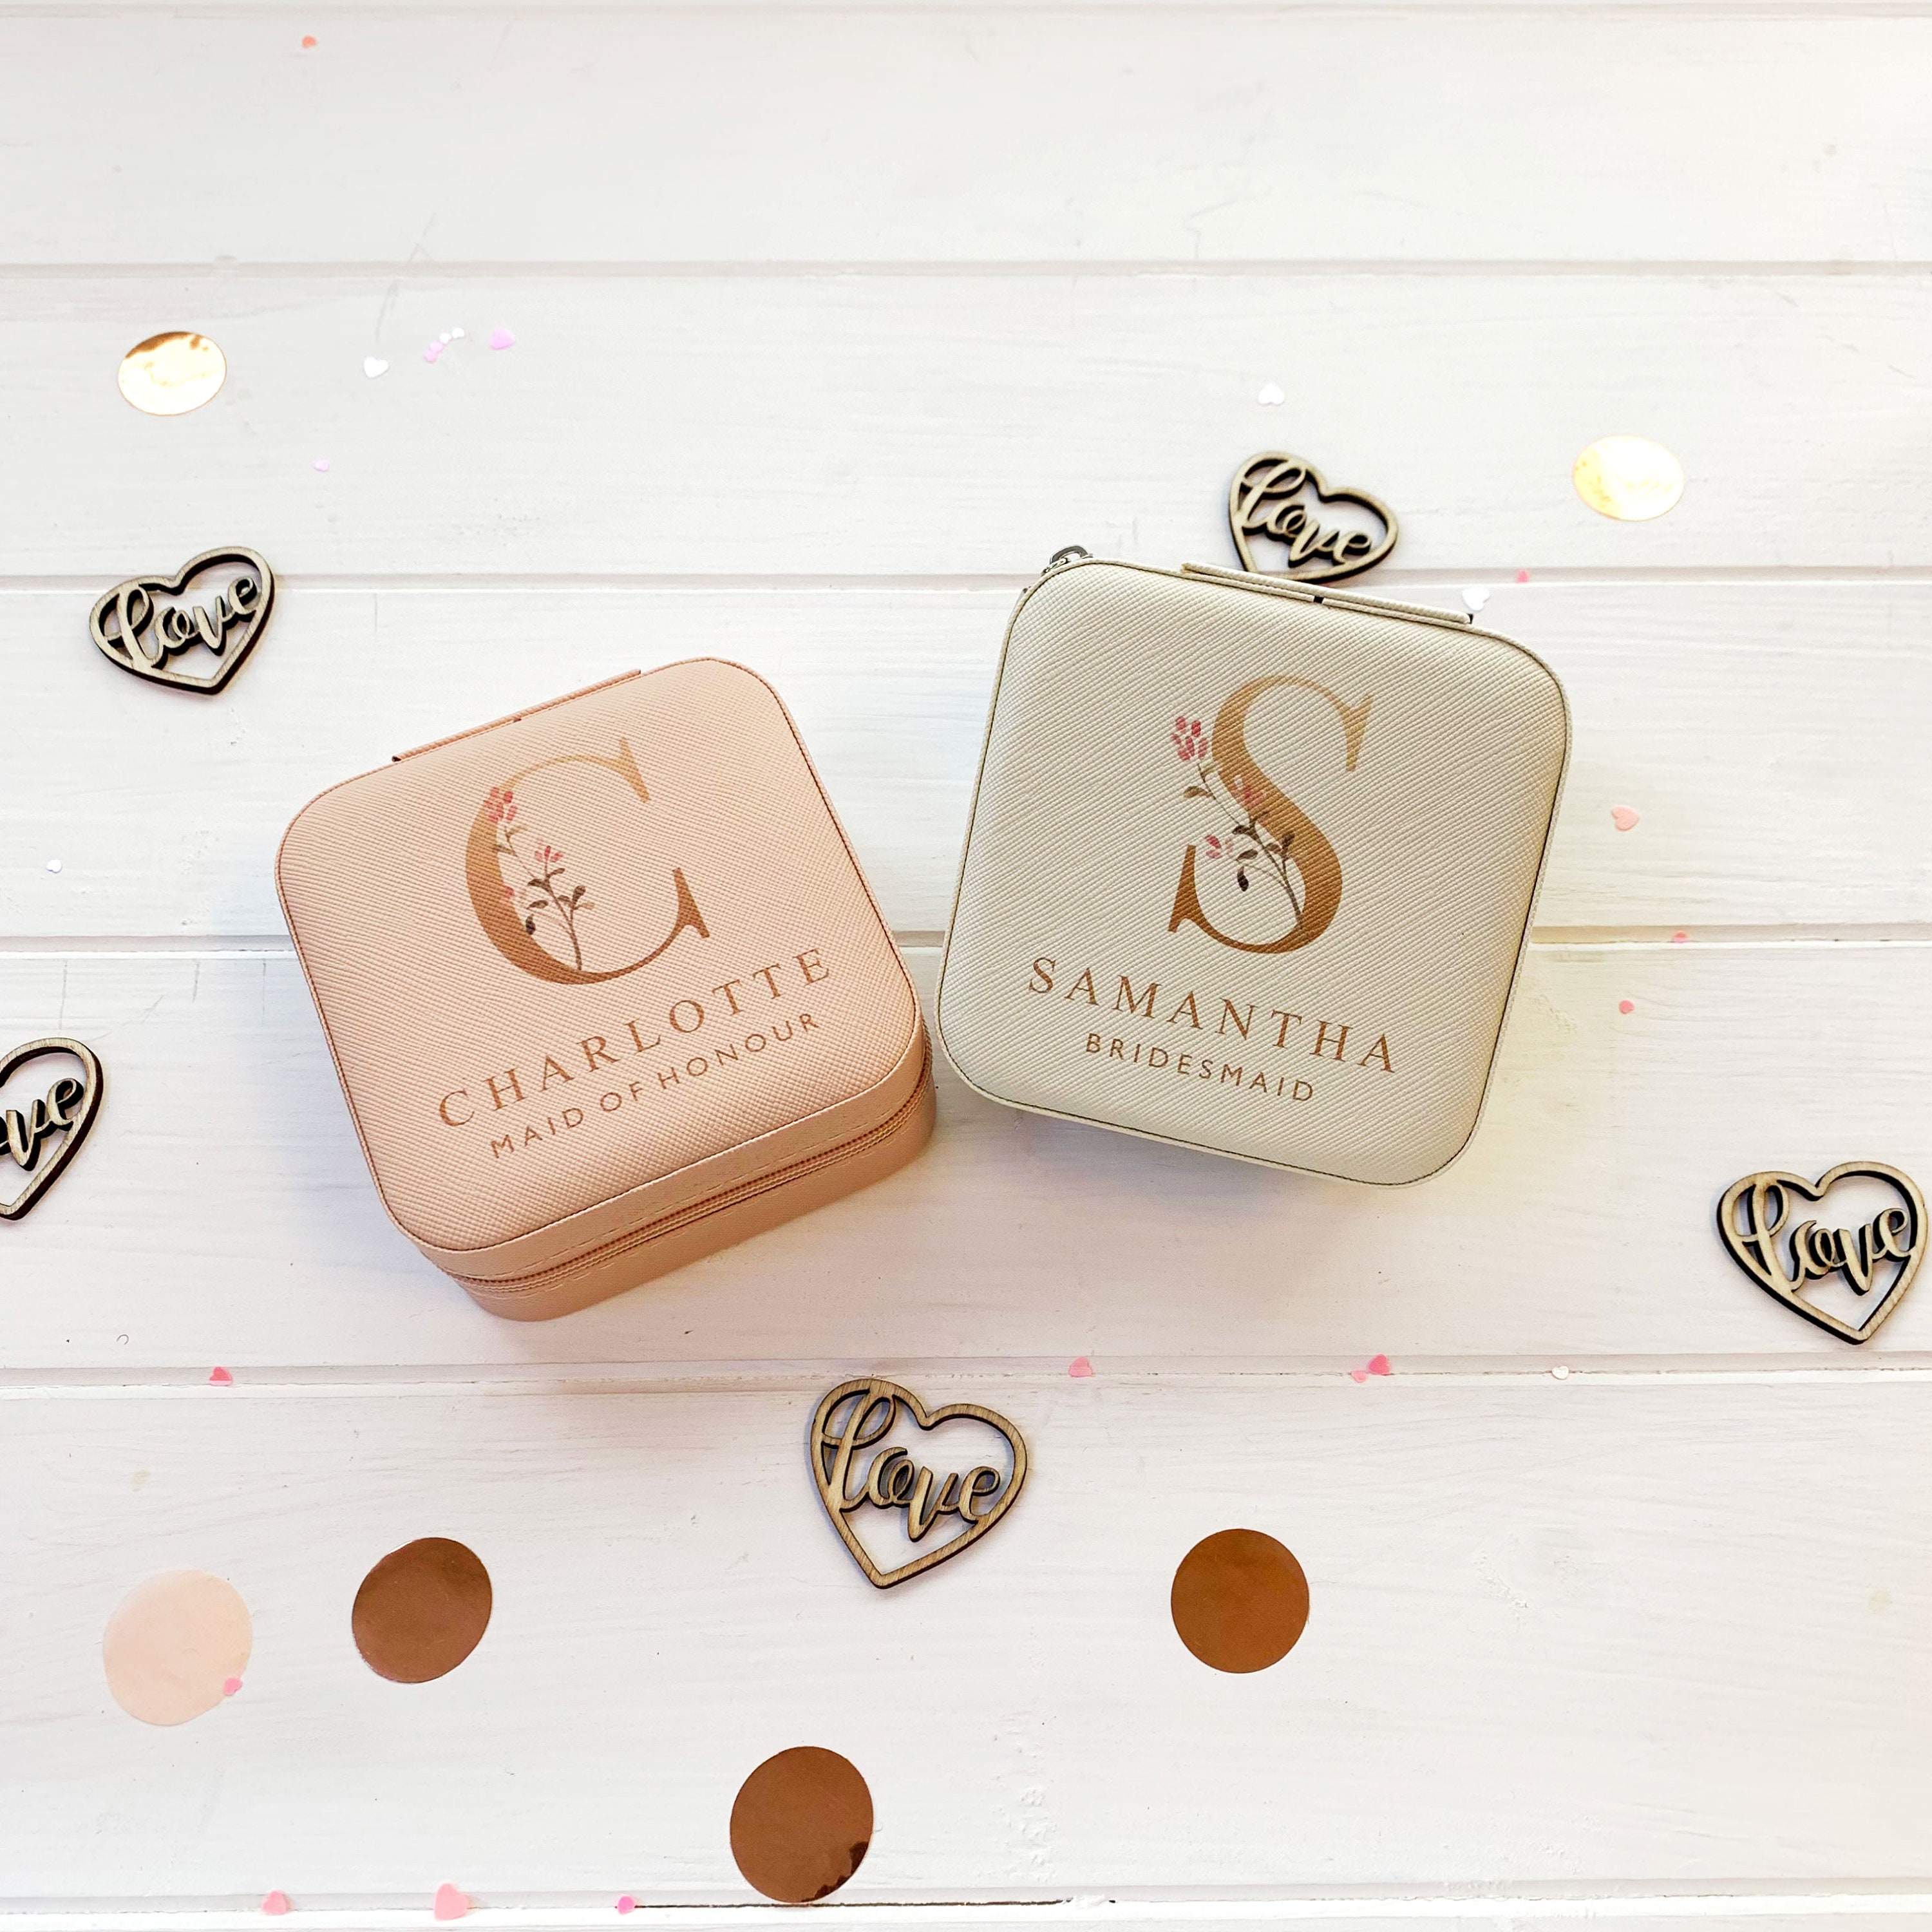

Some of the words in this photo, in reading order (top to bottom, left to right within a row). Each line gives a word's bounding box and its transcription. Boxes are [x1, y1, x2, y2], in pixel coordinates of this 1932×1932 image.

[1240, 459, 1372, 567] love
[103, 586, 256, 670] love
[439, 947, 831, 1128] CHARLOTTE
[1028, 957, 1396, 1074] SAMANTHA
[1086, 1033, 1315, 1103] BRIDESMAID
[490, 1106, 585, 1159] MAID
[600, 1083, 645, 1113] OF
[660, 1013, 820, 1090] HONOUR
[1735, 1183, 1909, 1296] love
[822, 1388, 1000, 1542] love
